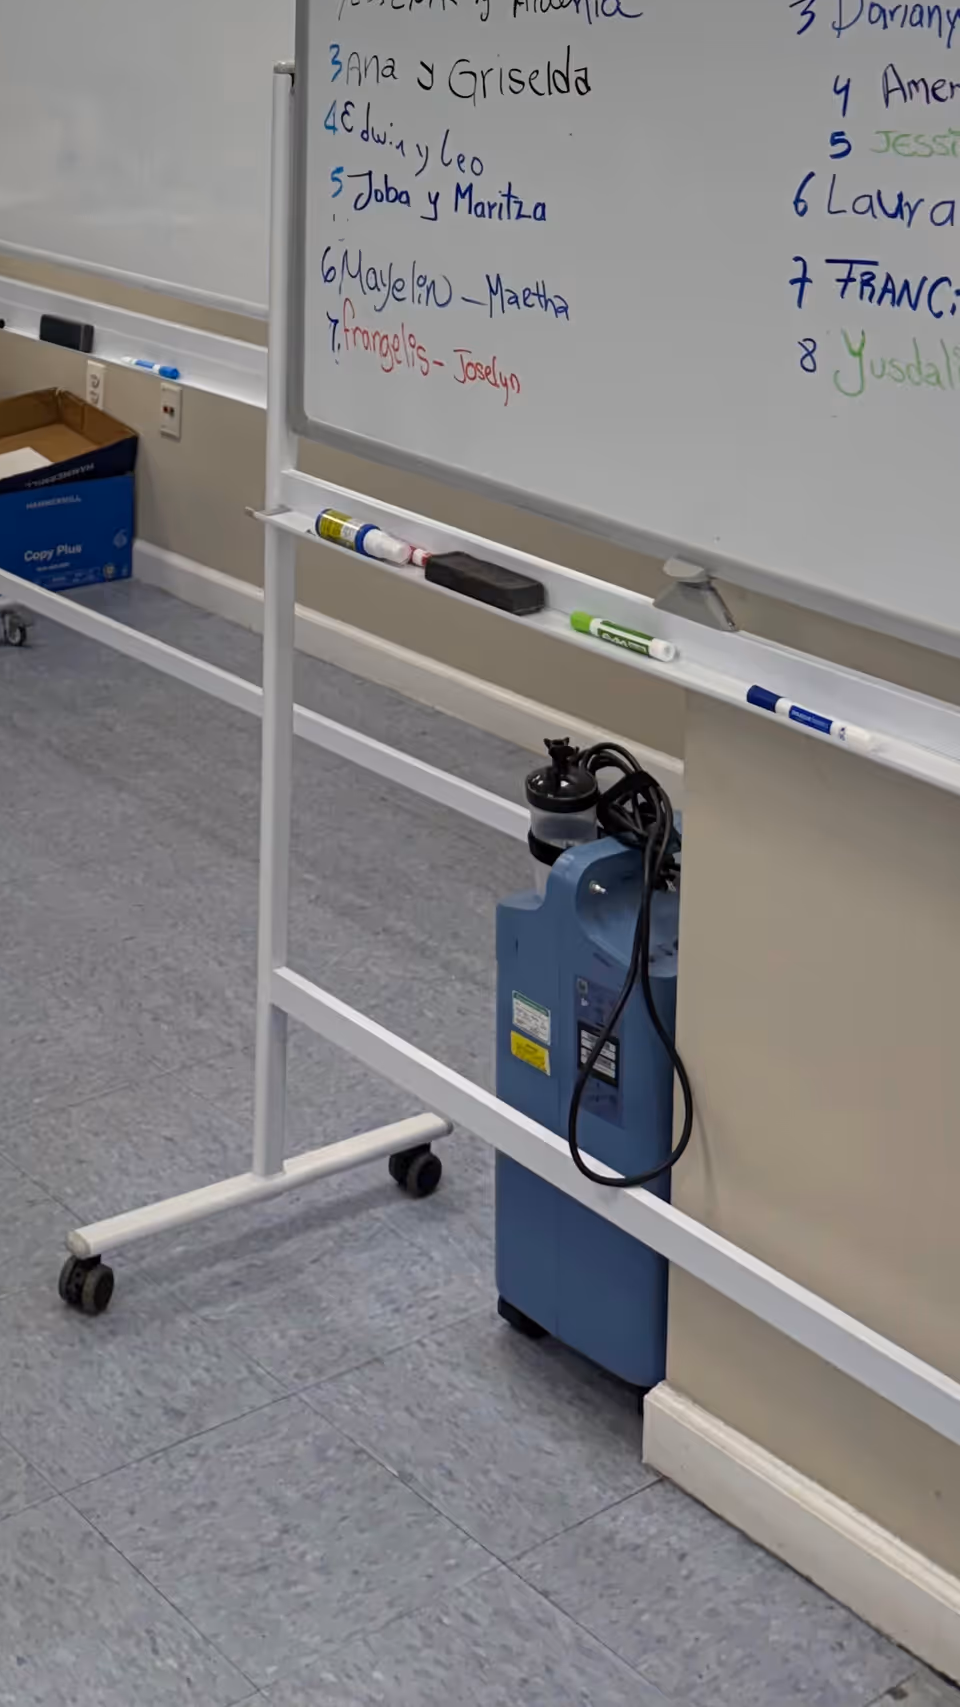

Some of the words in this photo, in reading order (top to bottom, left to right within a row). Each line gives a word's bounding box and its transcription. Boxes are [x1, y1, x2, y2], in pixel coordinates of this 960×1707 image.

[329, 44, 343, 82] 3
[346, 51, 398, 87] Ana
[448, 45, 592, 107] Griselda
[832, 74, 852, 118] 4
[324, 99, 339, 136] 4
[829, 130, 853, 160] 5
[330, 166, 345, 199] 5
[454, 181, 548, 222] Maritza
[792, 170, 816, 218] 6
[826, 172, 956, 229] Laura
[321, 245, 337, 284] 6
[789, 254, 814, 309] 7
[797, 337, 818, 374] 8
[24, 548, 55, 562] Copy
[56, 542, 83, 557] Plus
